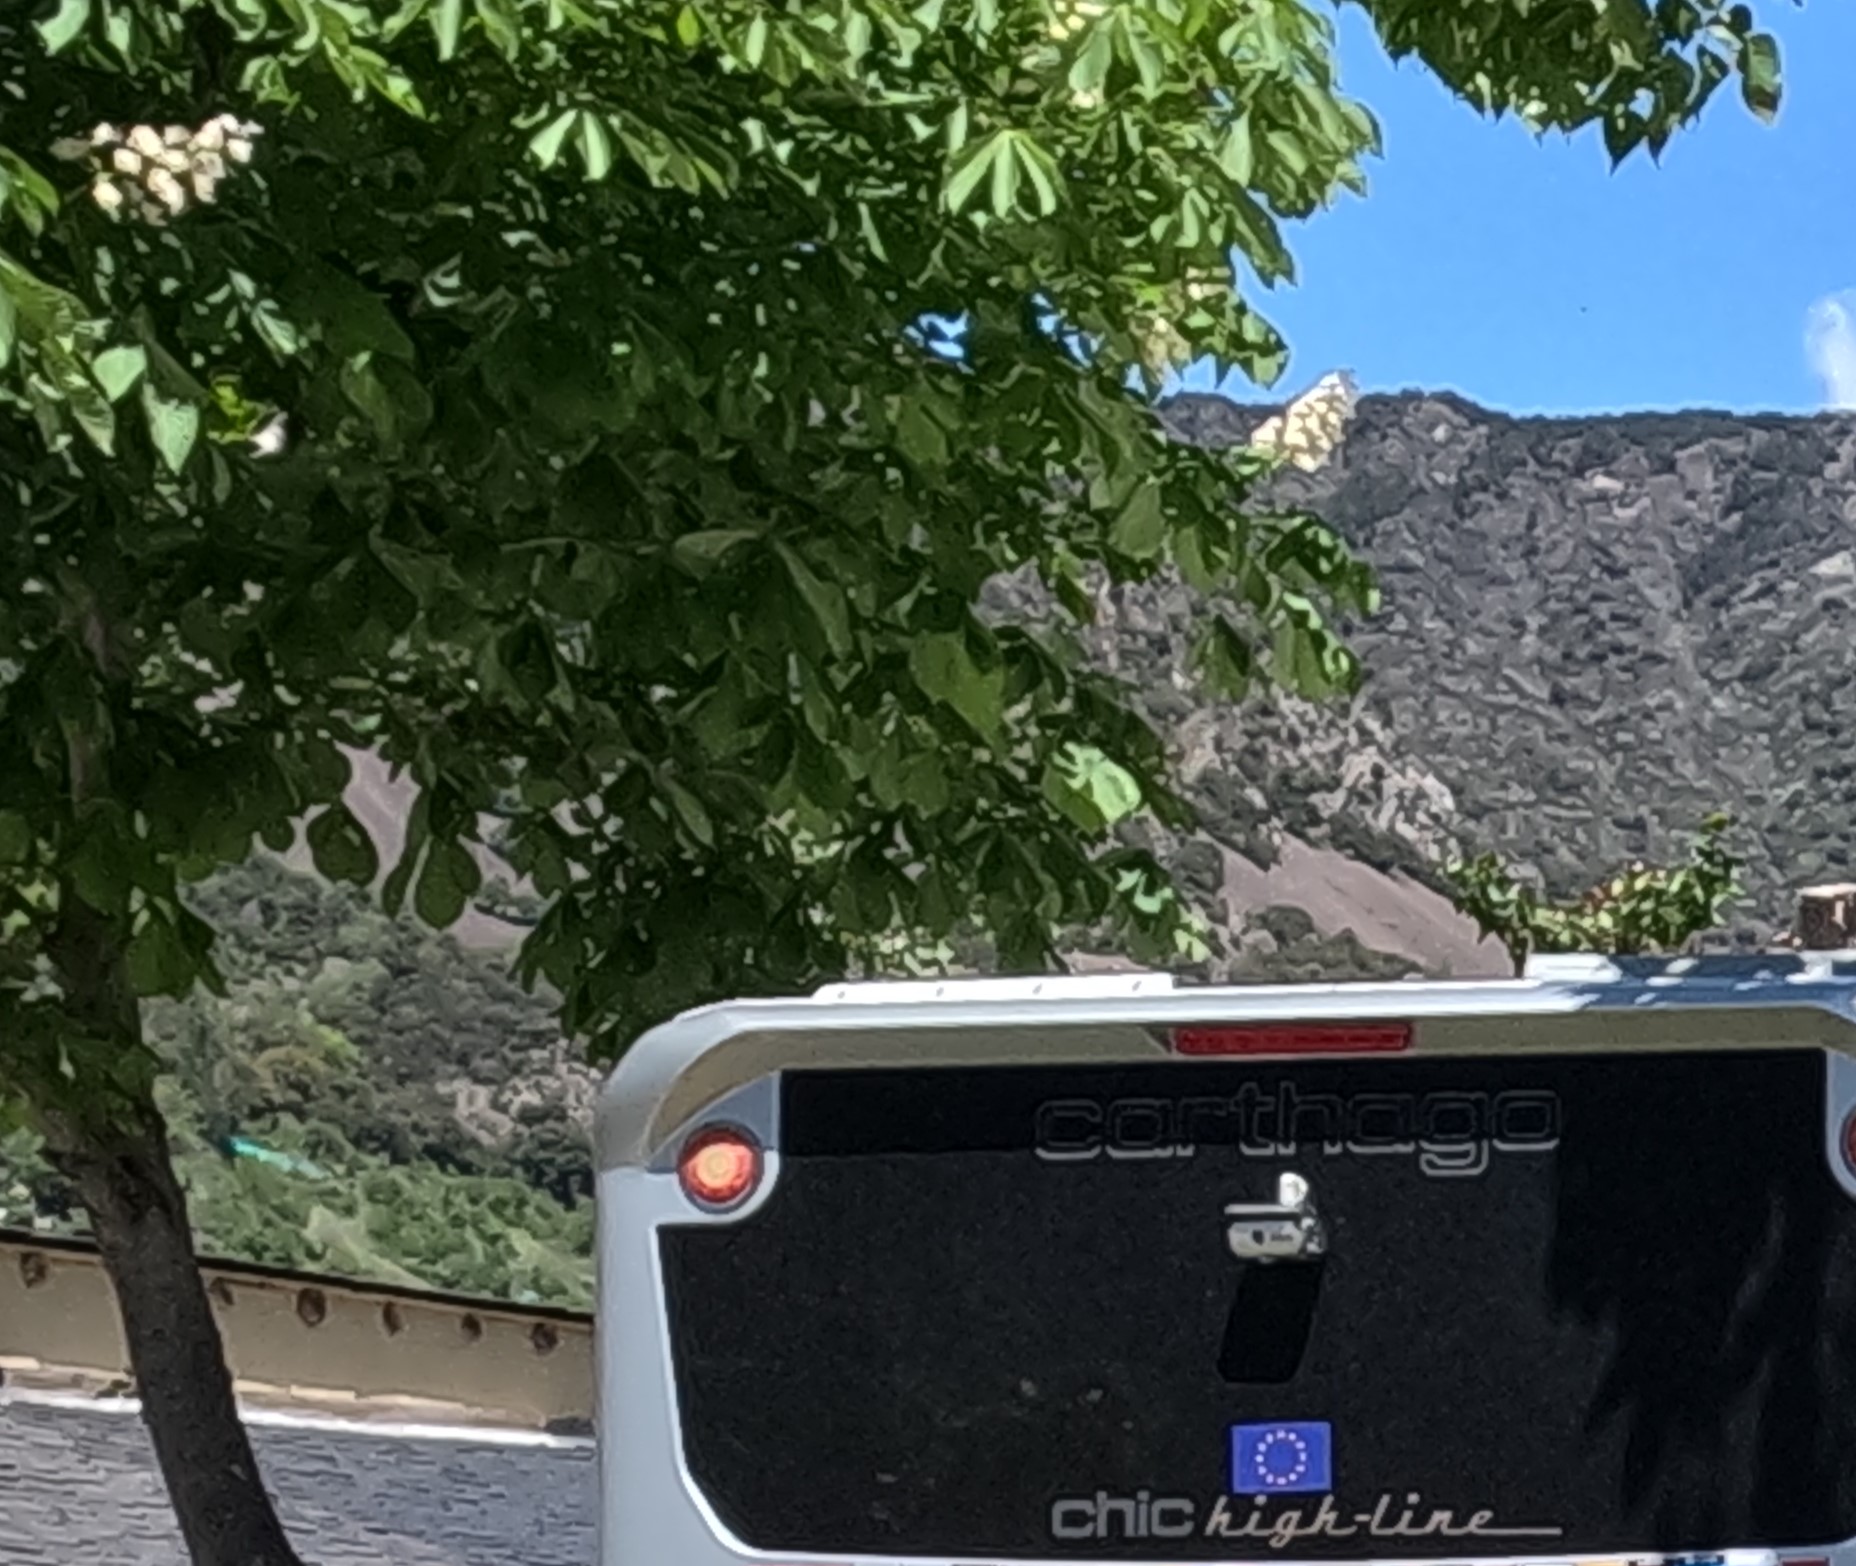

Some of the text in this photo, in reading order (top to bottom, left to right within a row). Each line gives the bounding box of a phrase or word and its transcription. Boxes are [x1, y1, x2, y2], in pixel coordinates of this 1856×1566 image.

[1034, 1080, 1560, 1177] carthago
[1051, 1490, 1564, 1548] chic high-line
